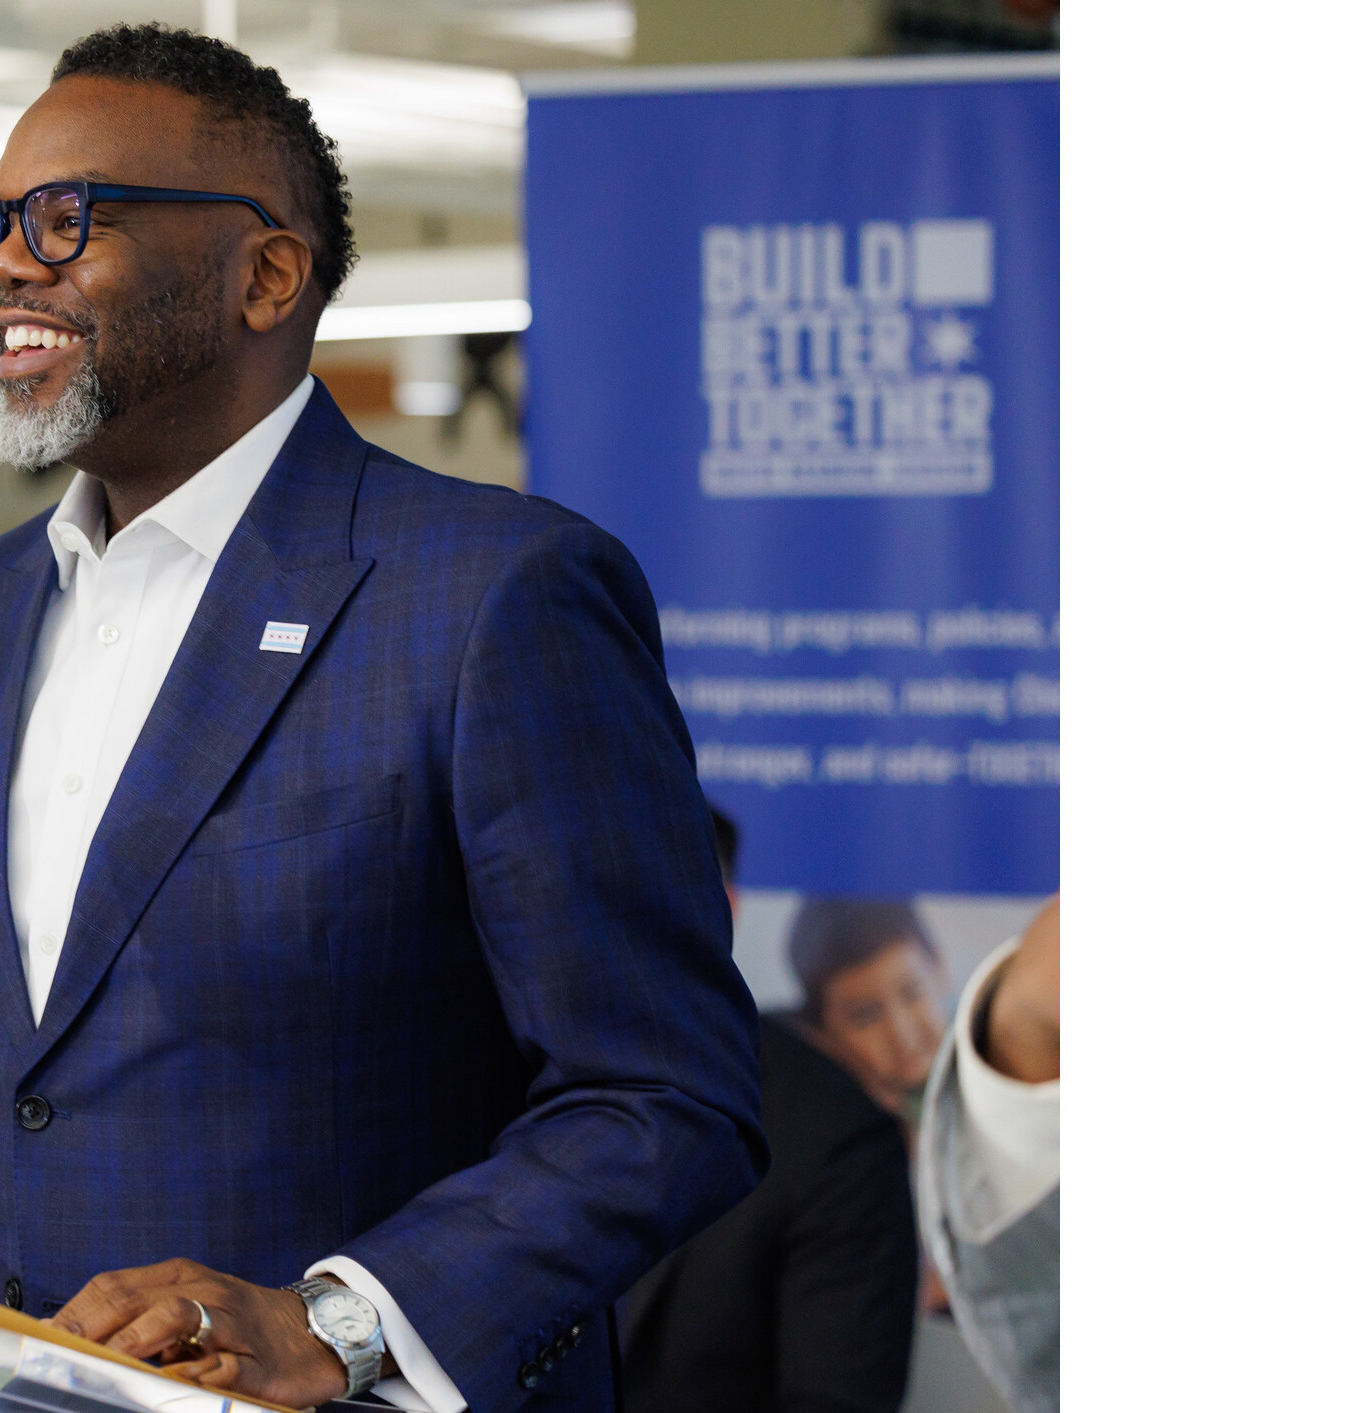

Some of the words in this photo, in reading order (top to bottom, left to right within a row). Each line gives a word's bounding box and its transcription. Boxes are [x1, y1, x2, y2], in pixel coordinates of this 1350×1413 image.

[702, 223, 906, 304] BUILD
[702, 312, 909, 382] BETTER
[706, 374, 992, 448] TOGETHER
